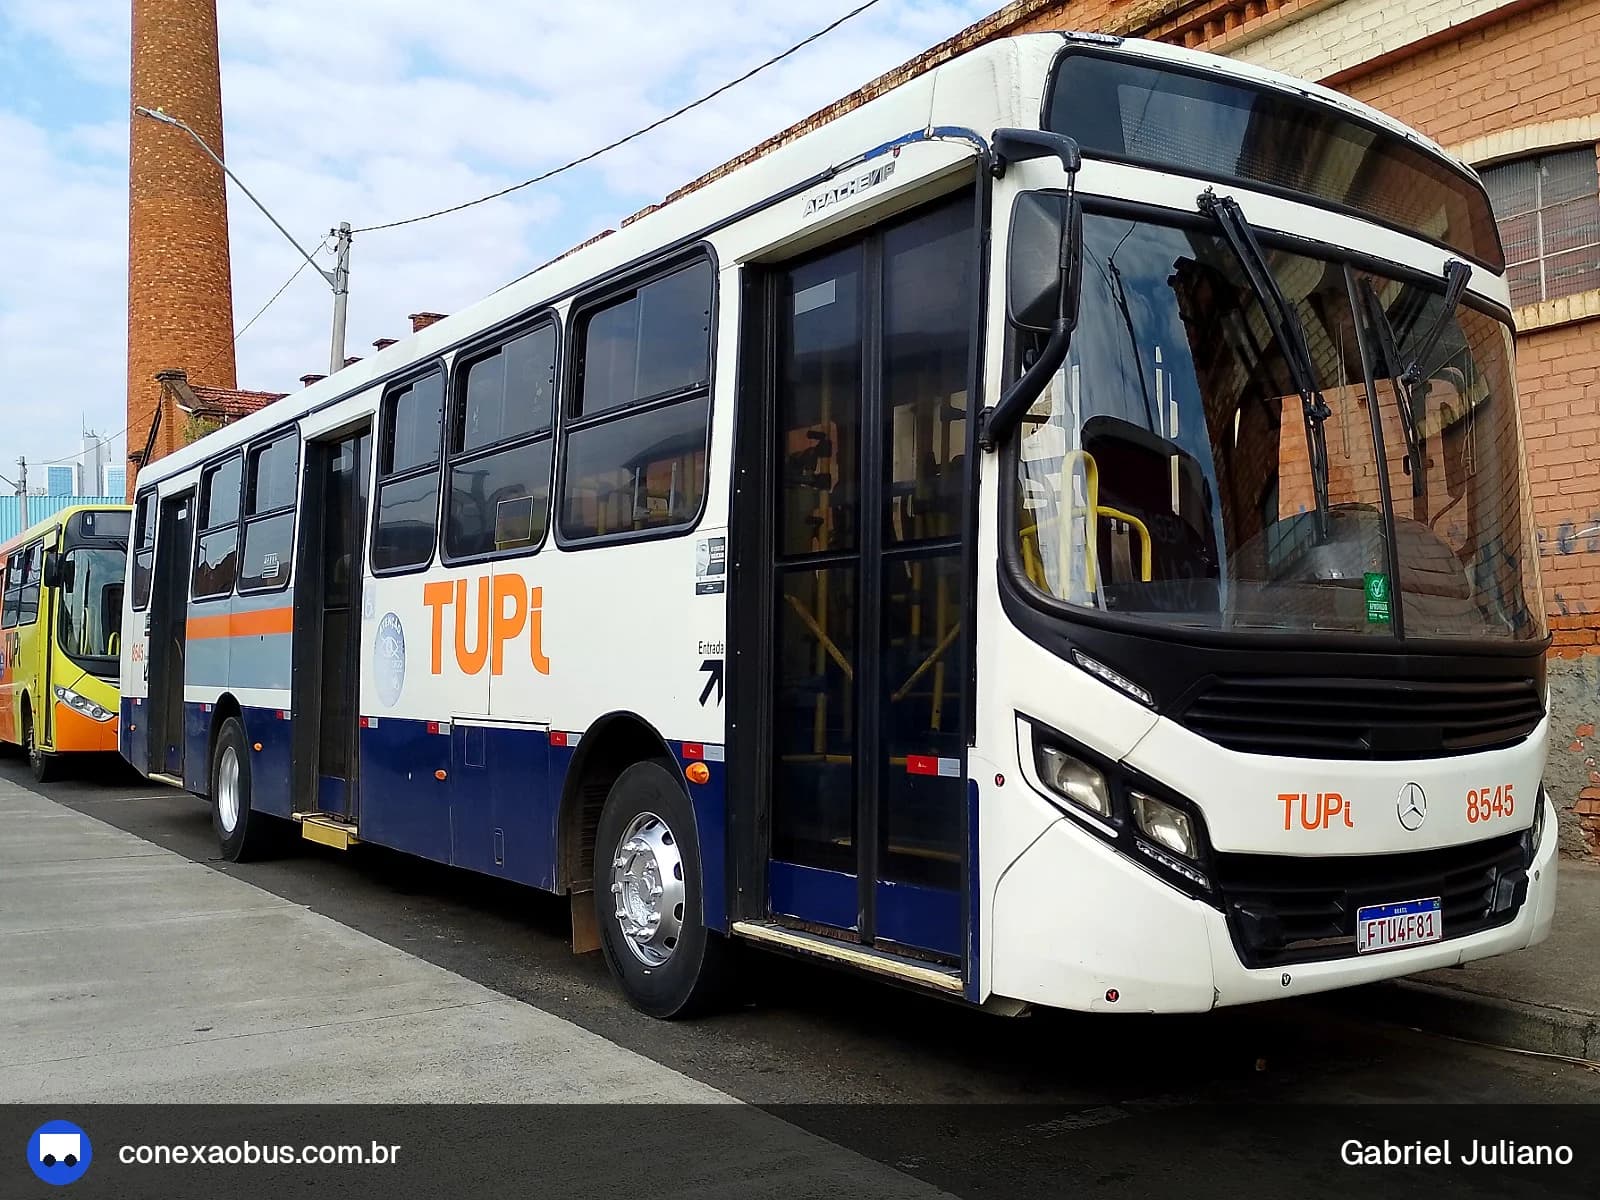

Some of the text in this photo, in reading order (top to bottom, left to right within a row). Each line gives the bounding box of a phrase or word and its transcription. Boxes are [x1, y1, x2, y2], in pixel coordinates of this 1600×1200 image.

[423, 573, 550, 675] TUPi
[698, 640, 724, 655] Entrada
[1277, 793, 1354, 830] TUPi
[1466, 784, 1514, 823] 8545
[1367, 913, 1434, 947] FTU4F81
